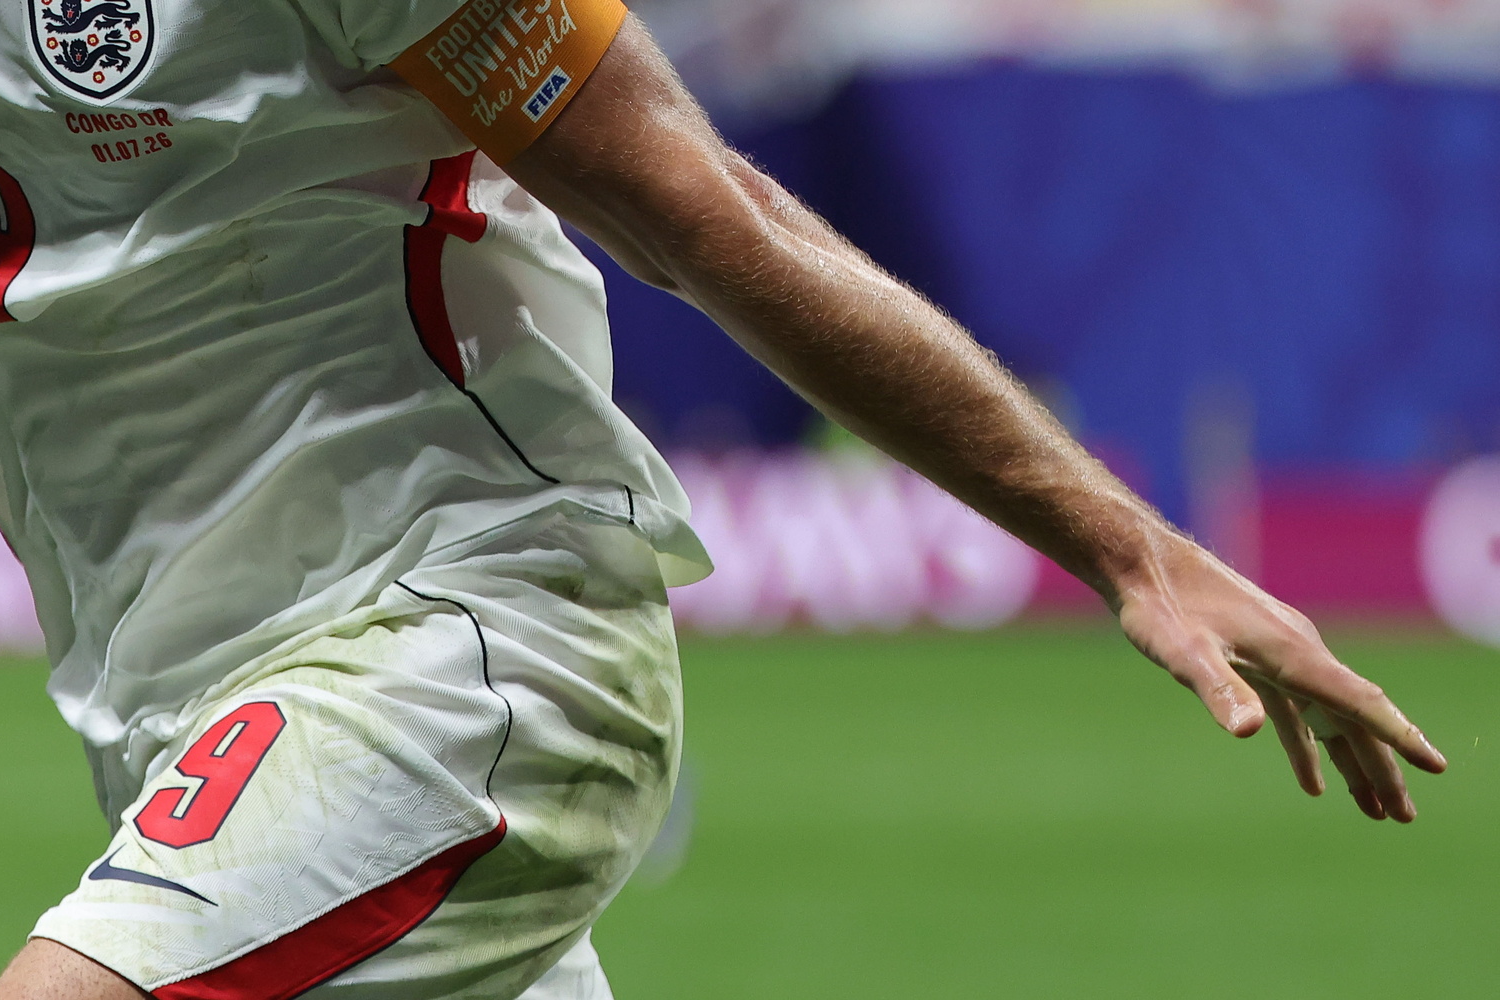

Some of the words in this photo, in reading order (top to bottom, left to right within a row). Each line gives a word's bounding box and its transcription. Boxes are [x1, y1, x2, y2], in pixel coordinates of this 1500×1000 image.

[471, 88, 513, 127] the
[505, 0, 577, 90] World
[527, 74, 567, 117] FIFA
[65, 111, 138, 134] CONGO
[137, 107, 174, 127] DR
[91, 131, 173, 163] 01.07.26
[133, 701, 288, 850] 9
